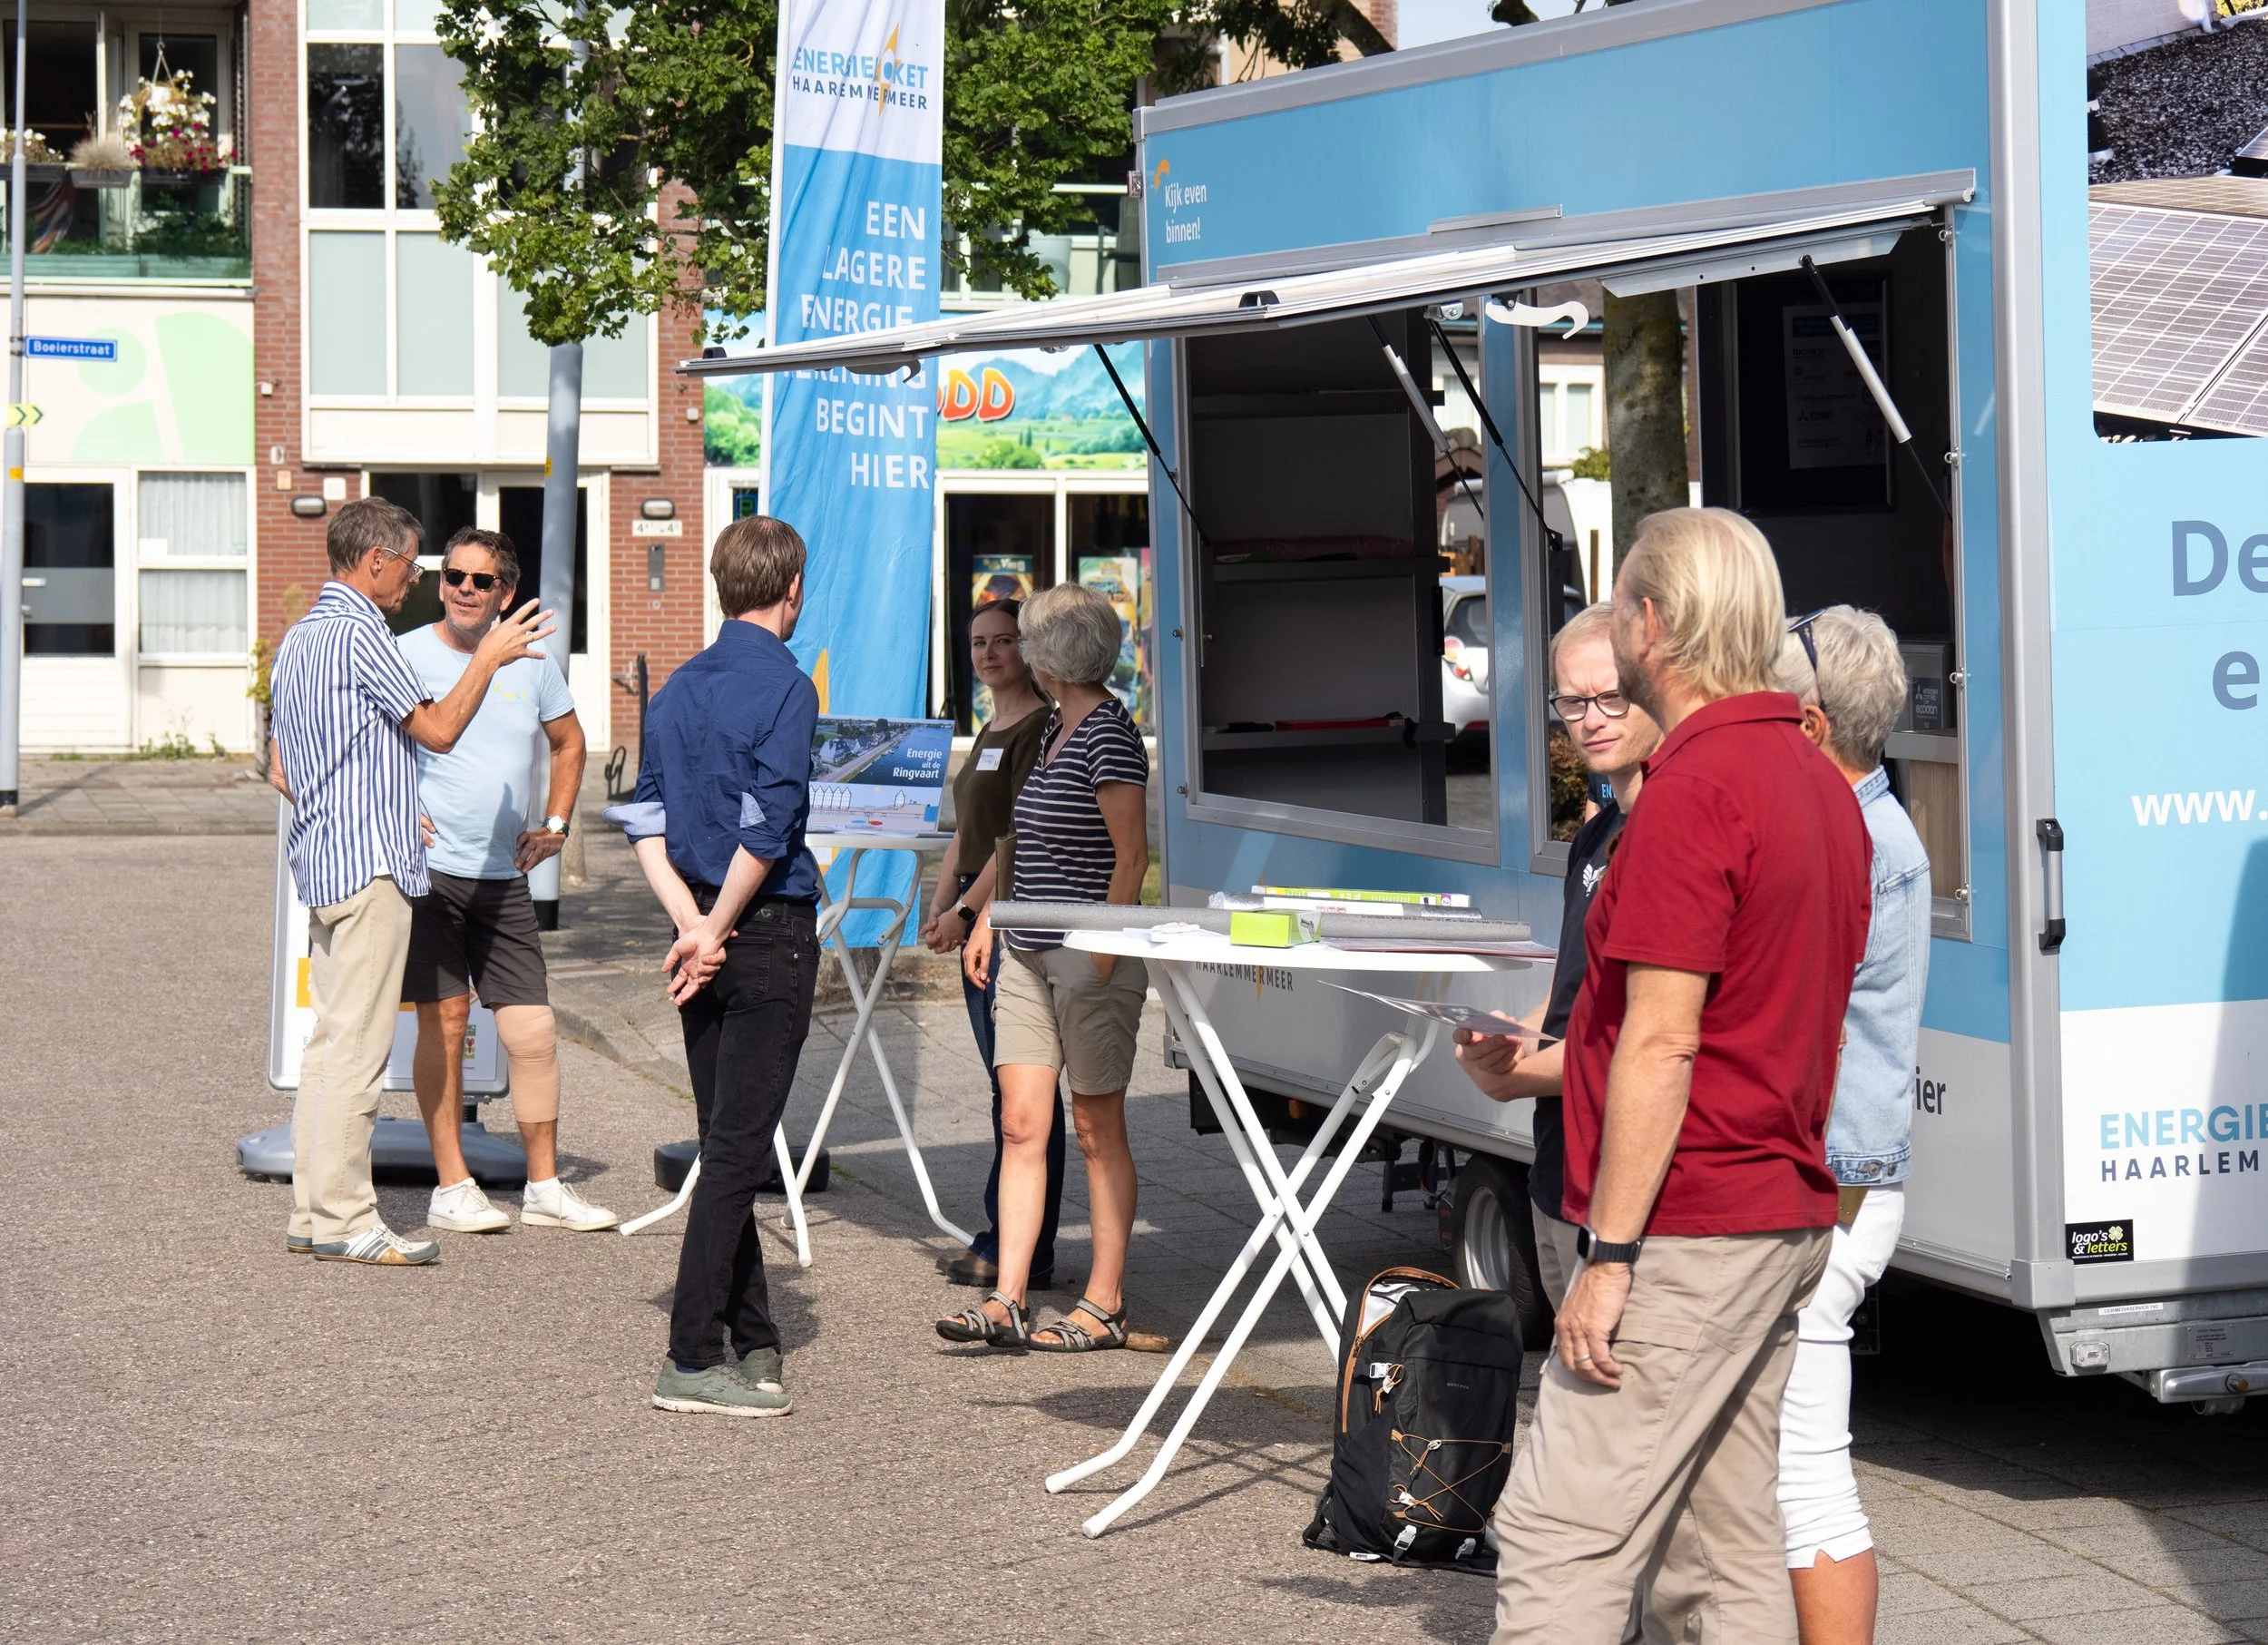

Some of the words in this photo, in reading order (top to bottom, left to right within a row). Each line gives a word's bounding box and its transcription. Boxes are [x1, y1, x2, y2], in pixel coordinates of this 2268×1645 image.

[1165, 181, 1183, 214] Kijk
[1184, 184, 1207, 205] even
[865, 201, 925, 240] EEN
[1166, 217, 1201, 243] binnen!
[822, 247, 926, 290] LAGERE
[34, 340, 110, 356] Boeierstraat
[937, 367, 1015, 422] DD
[816, 398, 929, 439] BEGINT
[850, 451, 930, 490] HIER
[906, 749, 943, 761] Energie
[893, 767, 940, 780] Ringvaart
[2101, 1150, 2259, 1182] HAARLEM
[2072, 1229, 2108, 1245] logo's
[2073, 1242, 2086, 1255] &
[2087, 1241, 2127, 1254] letters
